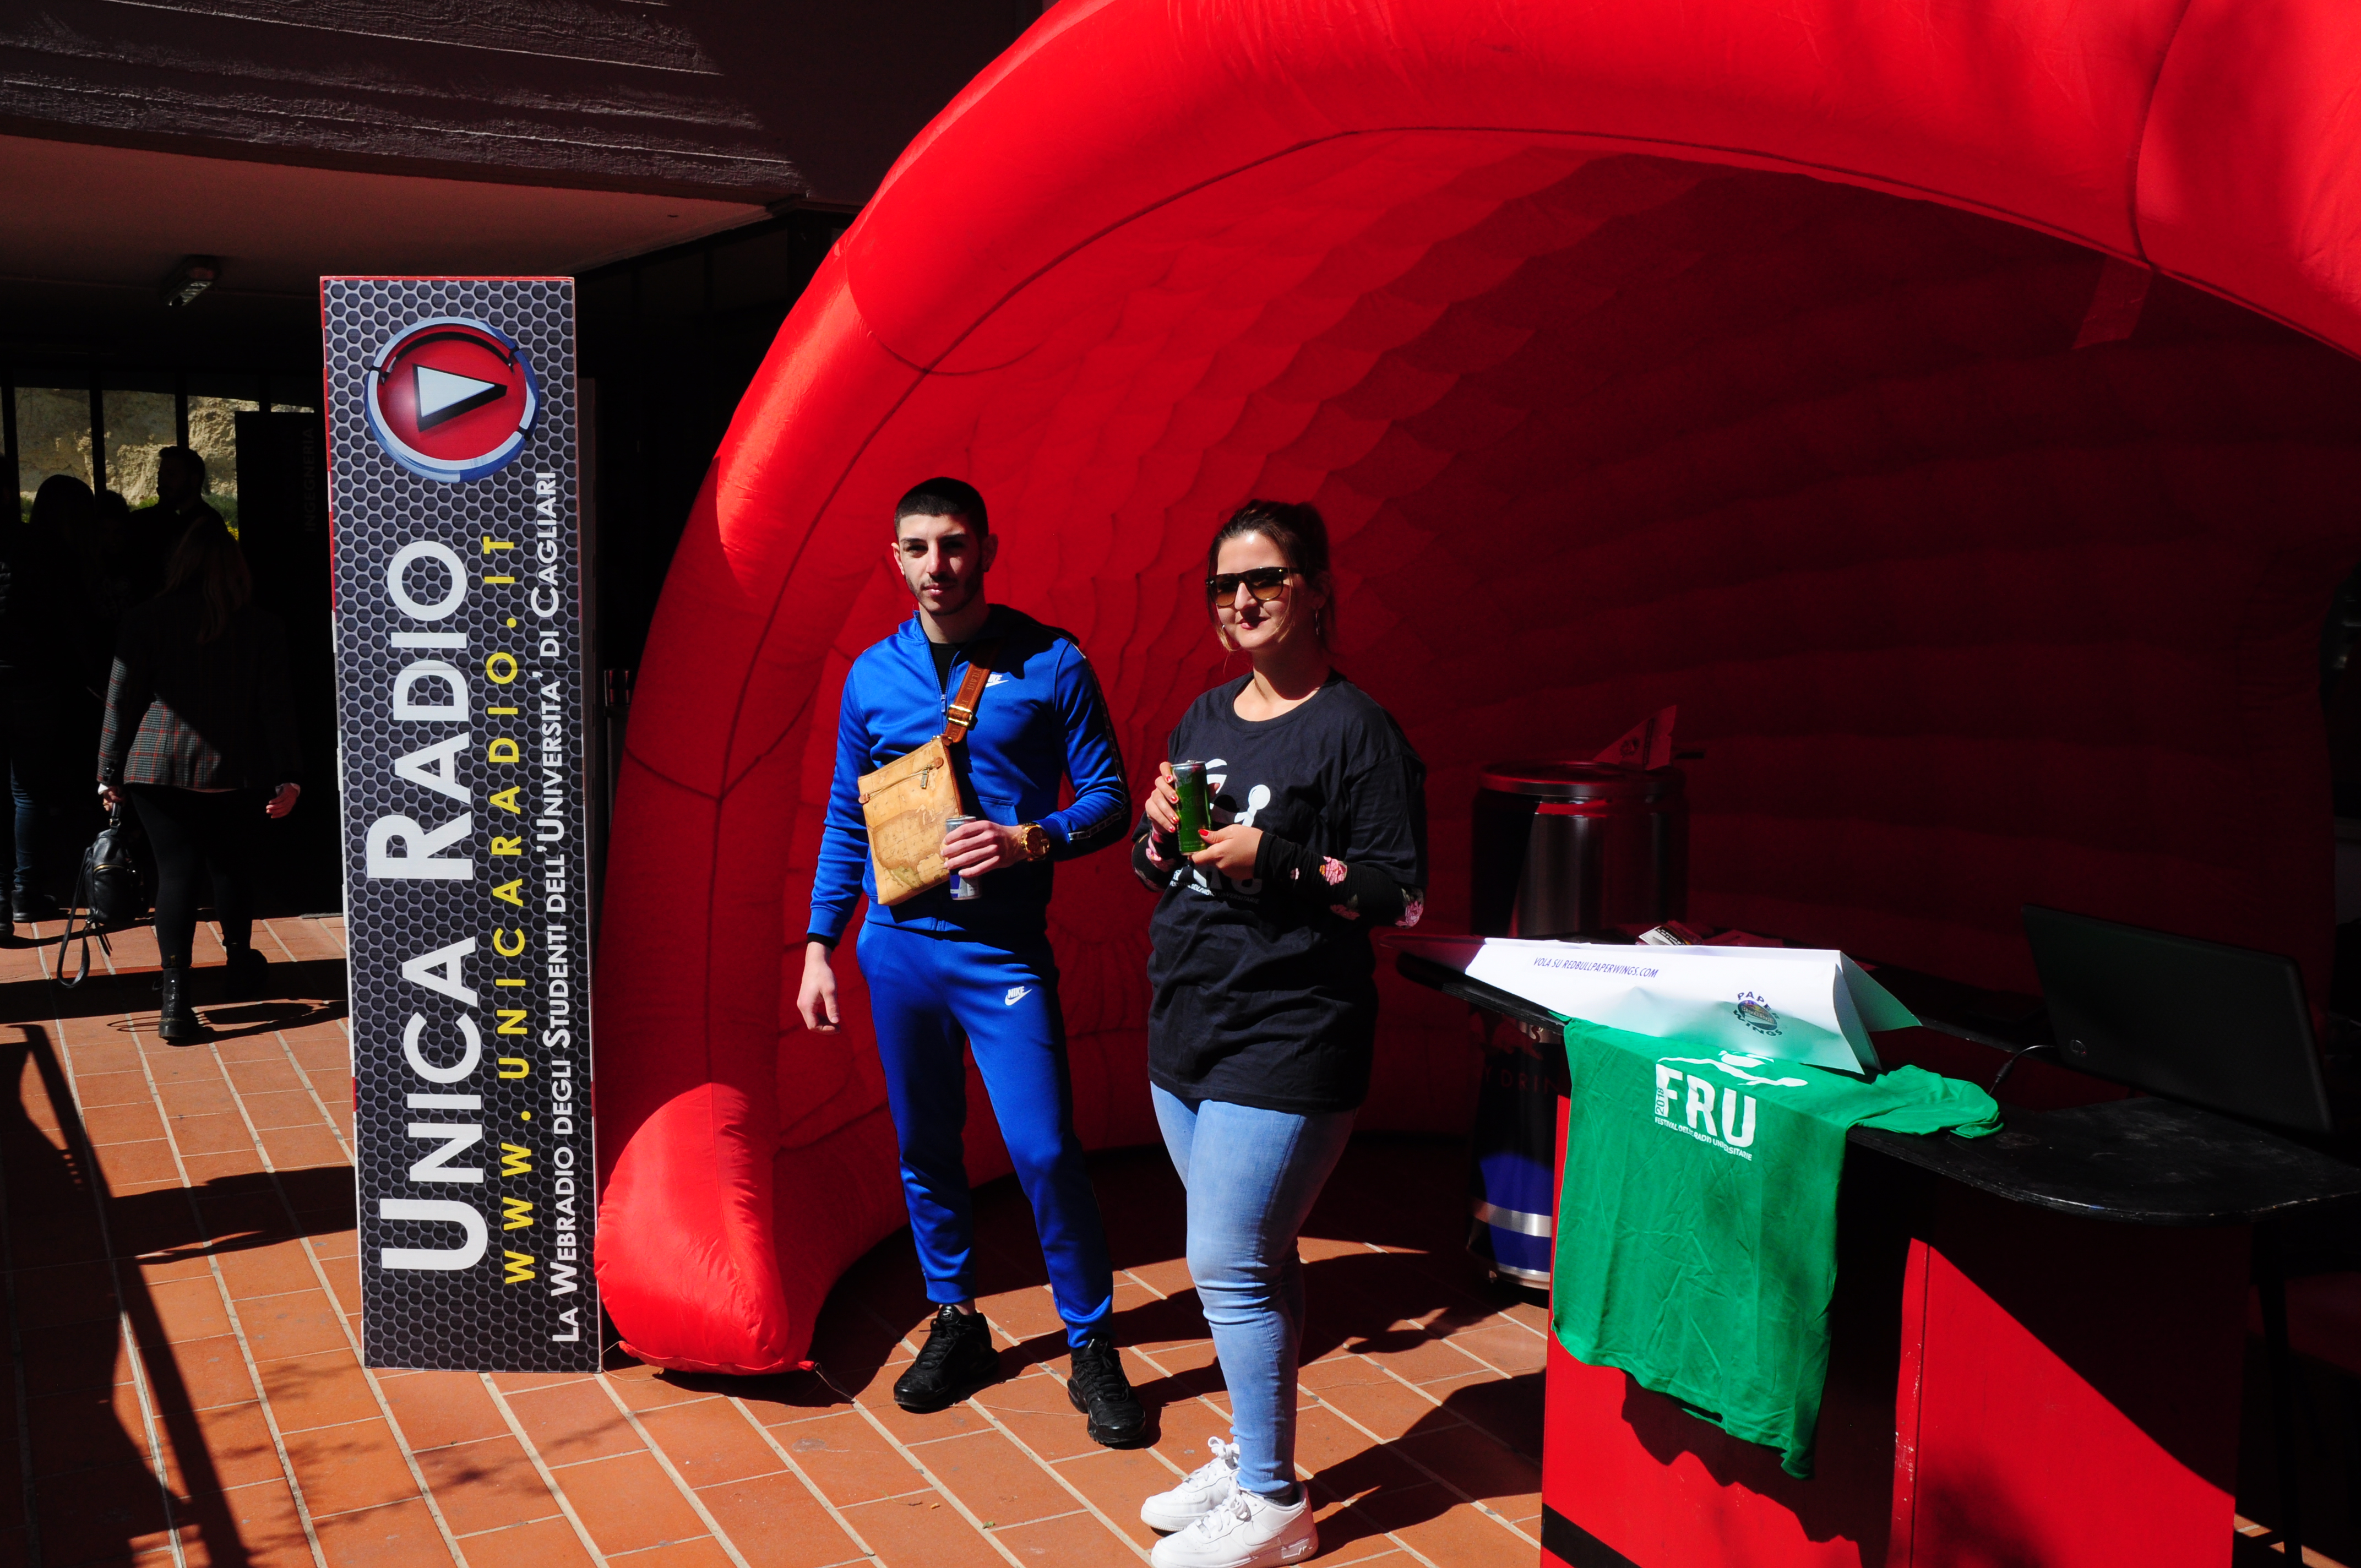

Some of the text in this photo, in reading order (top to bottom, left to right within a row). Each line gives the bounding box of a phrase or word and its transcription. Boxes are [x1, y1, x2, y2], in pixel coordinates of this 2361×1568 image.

[302, 427, 316, 532] INGEGNERIA
[530, 472, 559, 618] CAGLIARI
[540, 631, 559, 657] DI
[366, 541, 488, 1271] UNICA RADIO
[483, 536, 536, 1284] WWW.UNICARADIO.IT
[542, 925, 570, 1049] STUDENTI
[1008, 986, 1025, 999] NIKE
[1533, 957, 1659, 978] VOLA SU REDBULLPAPERWINGS.COM
[1737, 991, 1780, 1020] PAPER
[552, 1060, 573, 1135] DEGLI
[1655, 1063, 1756, 1147] FRU
[1655, 1116, 1678, 1131] FESTIVAL
[1656, 1086, 1664, 1115] 2018
[550, 1147, 578, 1297] WEBRADIO
[552, 1308, 579, 1341] LA
